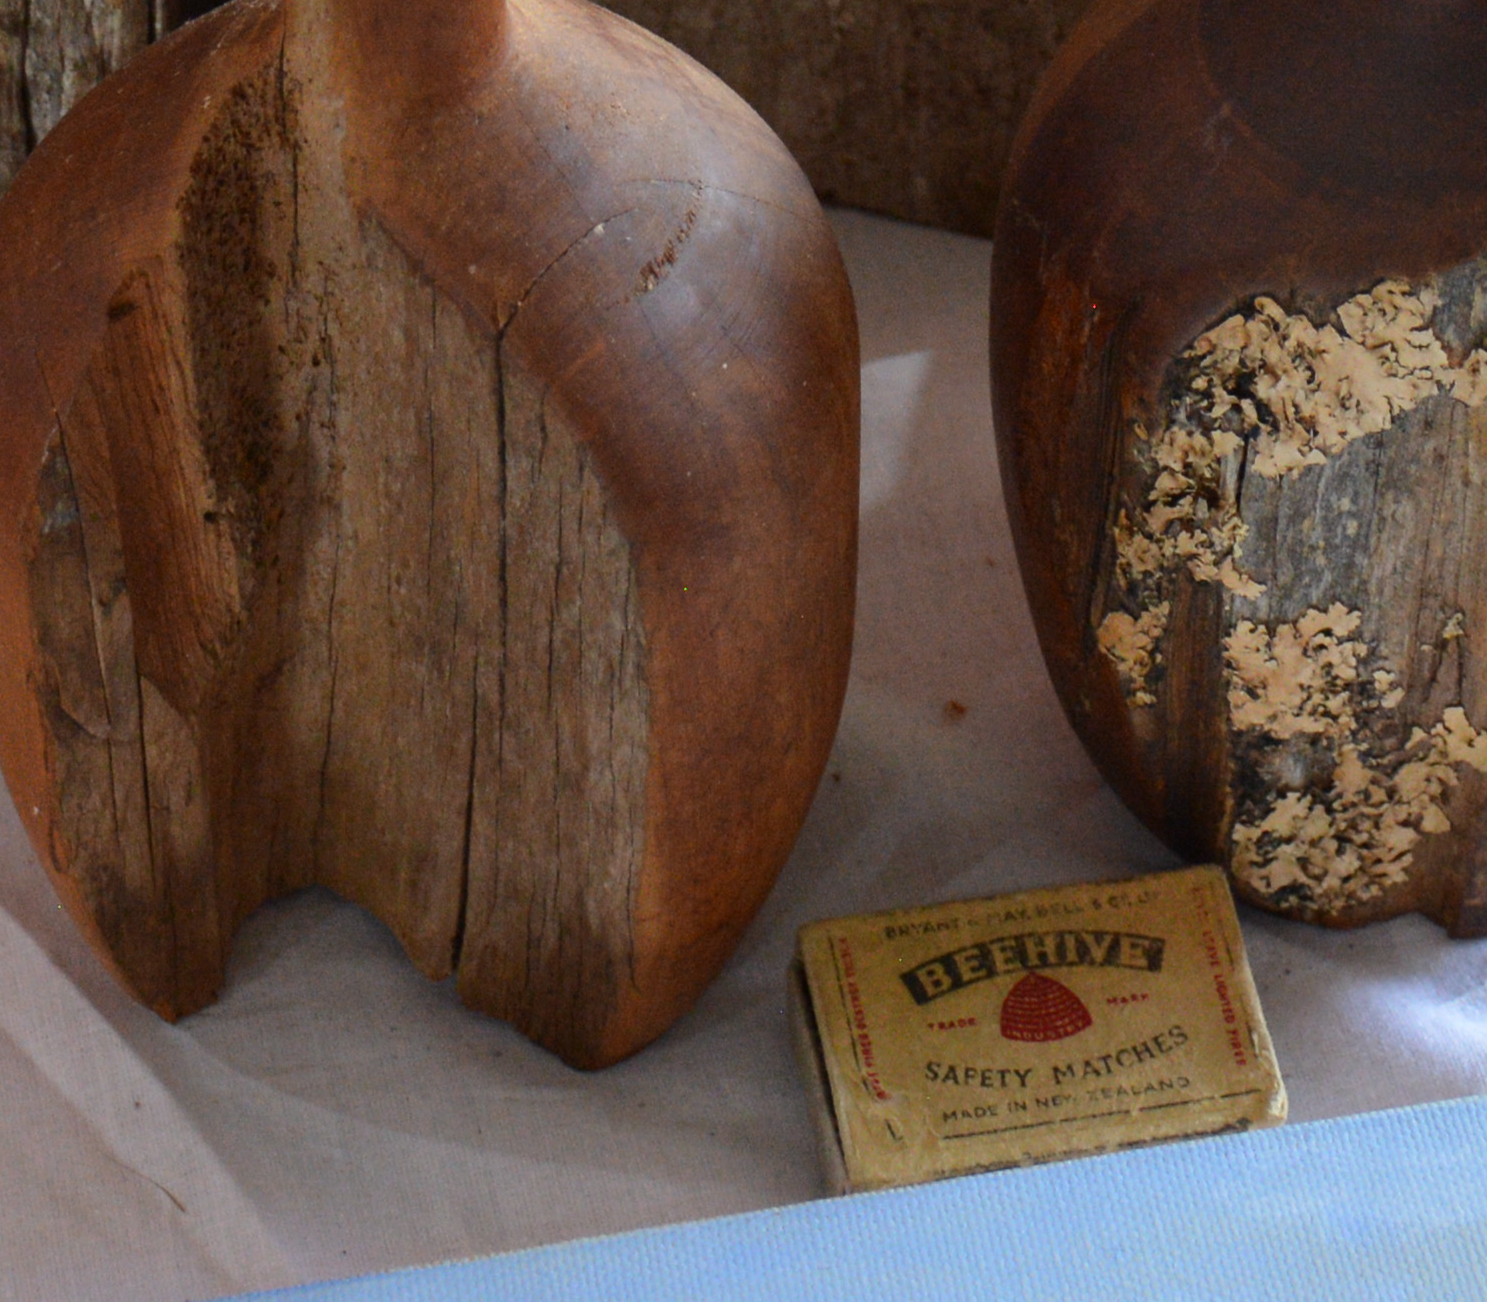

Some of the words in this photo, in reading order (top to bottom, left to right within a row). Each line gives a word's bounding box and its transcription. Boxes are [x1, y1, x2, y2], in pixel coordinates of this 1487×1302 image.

[914, 932, 1151, 998] BEEHIVE
[927, 1016, 977, 1032] TRADE
[1106, 992, 1150, 1005] MARK
[1214, 973, 1236, 1025] LIGHTED
[1227, 1028, 1247, 1067] FIRES
[925, 1060, 1033, 1088] SAFETY
[1052, 1024, 1189, 1085] MATCHES
[943, 1104, 999, 1123] MADE
[1008, 1099, 1028, 1114] IN
[1035, 1094, 1077, 1110] NEW
[1086, 1076, 1192, 1097] ZEALAND
